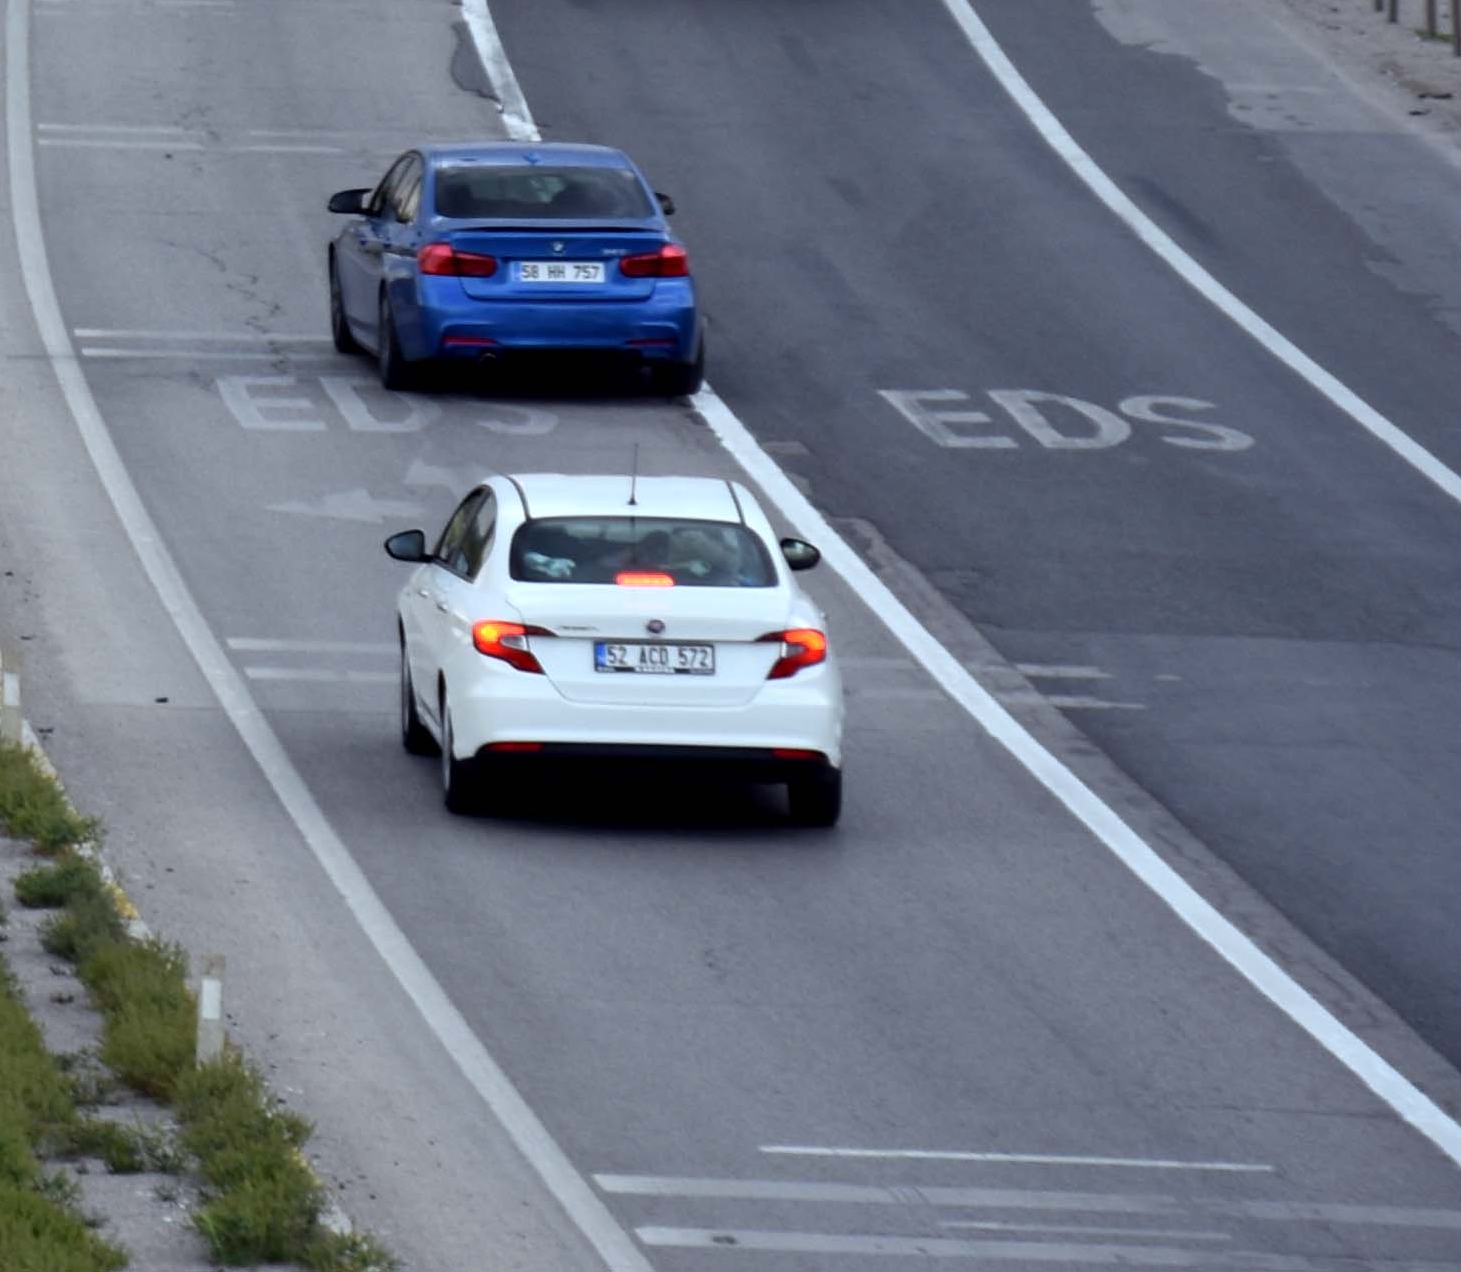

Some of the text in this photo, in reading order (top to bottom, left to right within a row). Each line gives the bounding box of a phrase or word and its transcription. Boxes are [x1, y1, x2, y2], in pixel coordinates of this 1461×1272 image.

[522, 264, 600, 279] 58 HH 757
[877, 389, 1254, 451] EDS
[607, 646, 710, 668] 52 ACD 572
